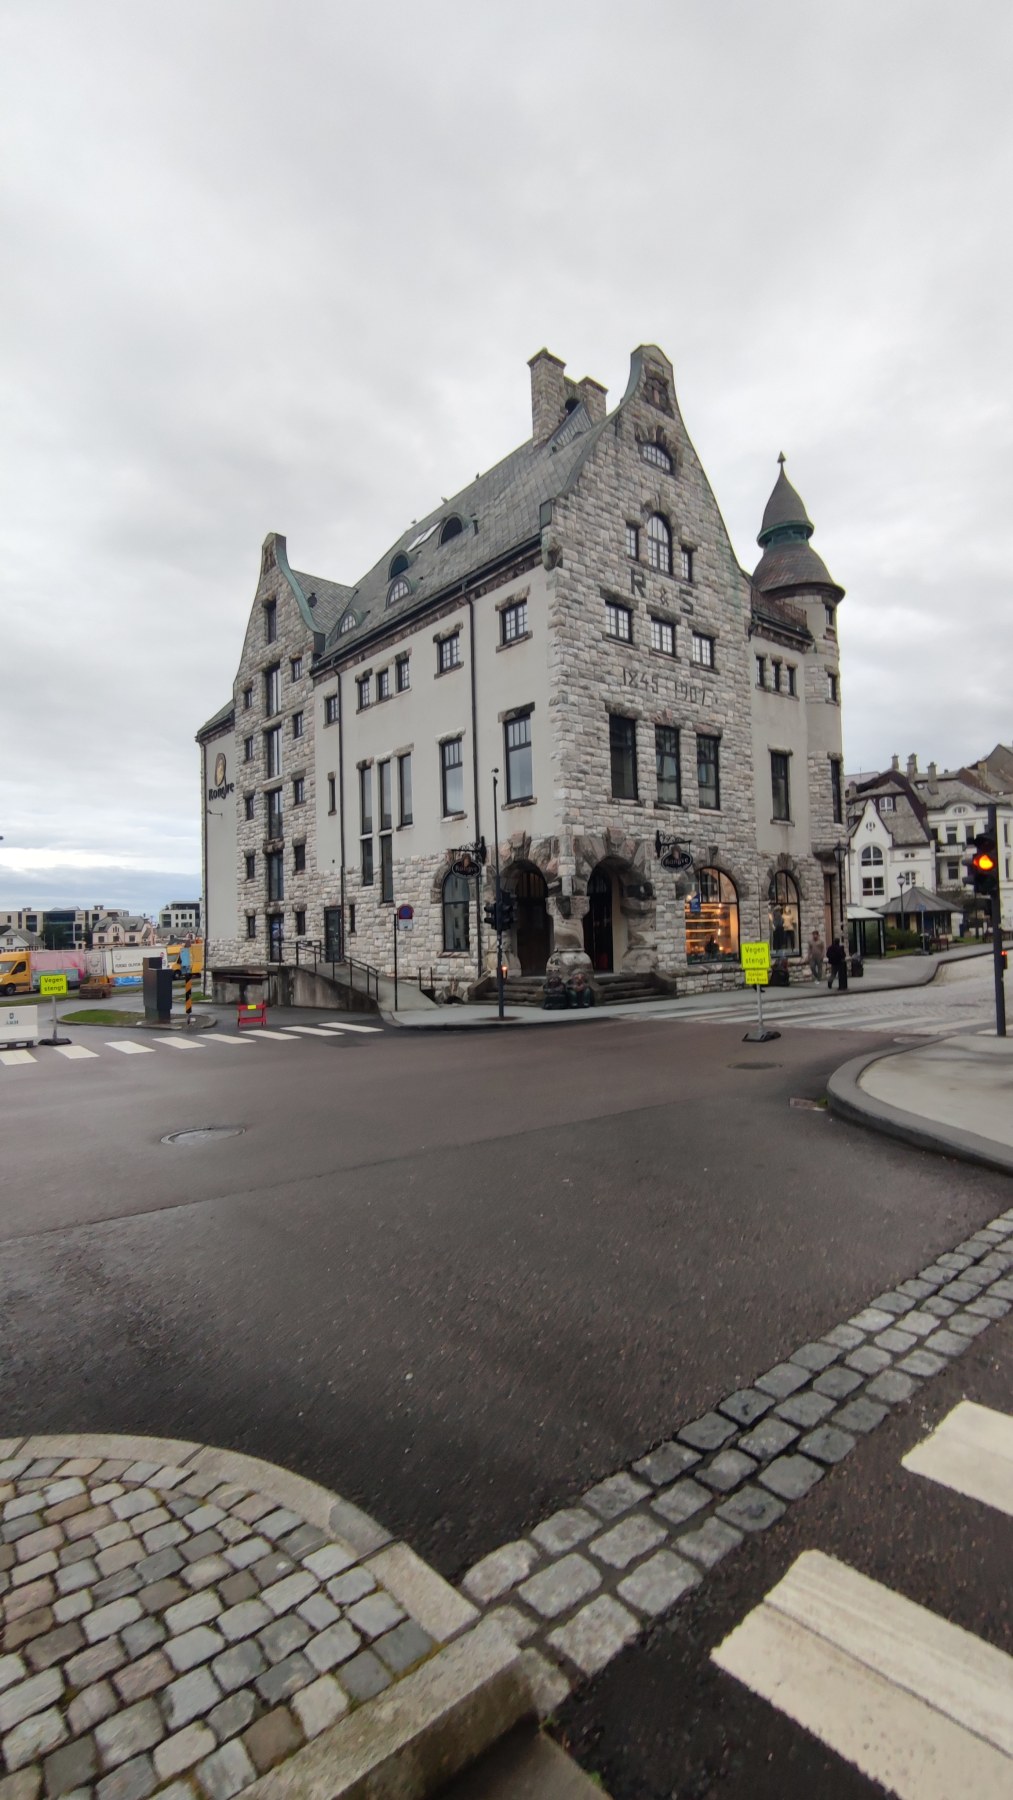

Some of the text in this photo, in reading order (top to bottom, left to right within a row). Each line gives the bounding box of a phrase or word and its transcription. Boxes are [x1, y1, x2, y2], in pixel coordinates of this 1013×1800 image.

[631, 567, 647, 597] R
[678, 588, 694, 616] S
[623, 667, 659, 694] 1845
[745, 945, 765, 955] Vegen
[745, 957, 766, 966] stengt
